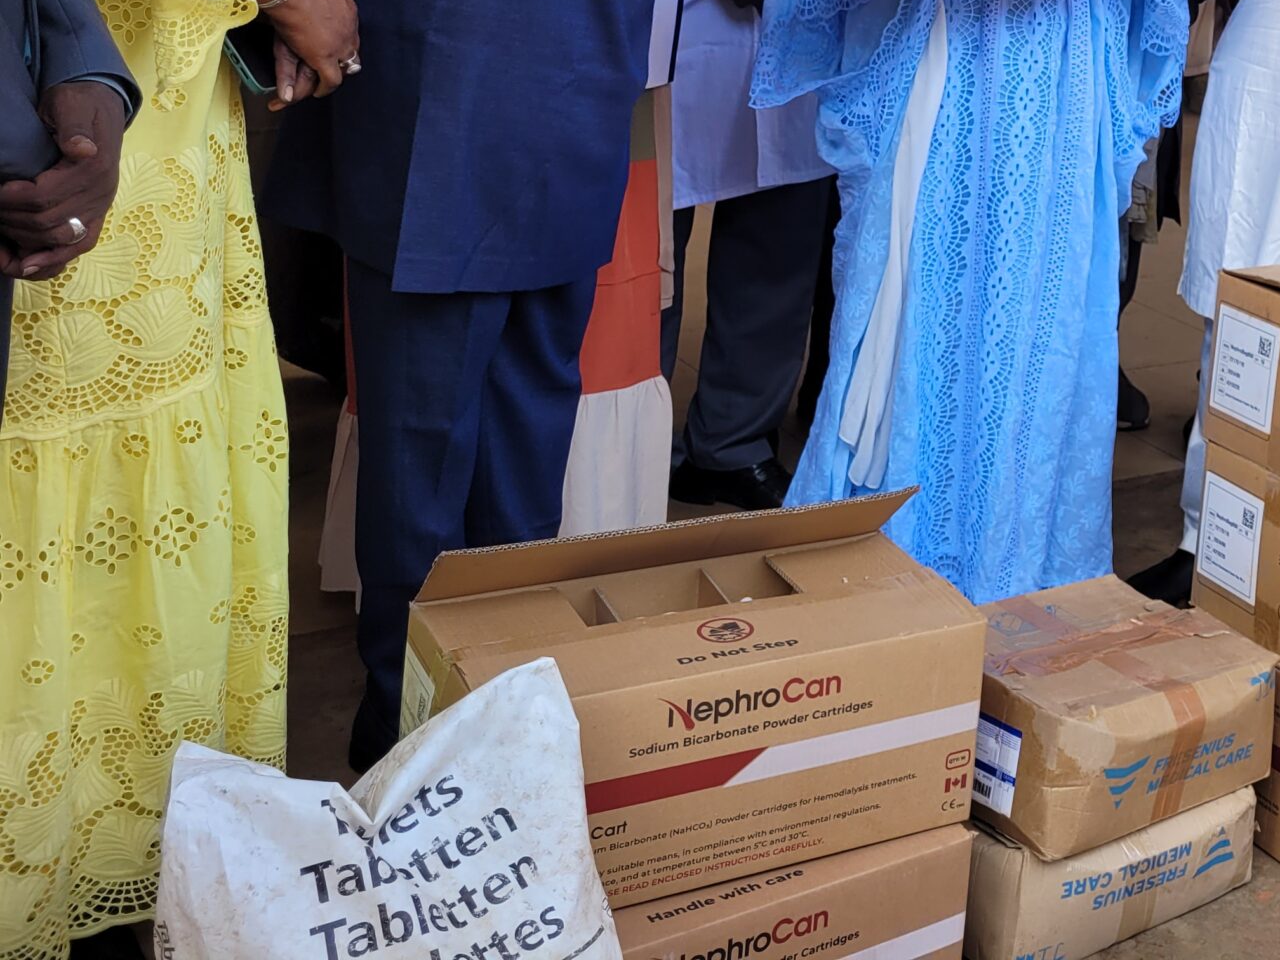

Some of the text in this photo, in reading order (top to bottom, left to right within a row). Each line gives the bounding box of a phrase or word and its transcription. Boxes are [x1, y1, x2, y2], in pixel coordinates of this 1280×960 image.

[677, 639, 799, 665] Do Not Step
[628, 700, 872, 758] Sodium Bicarbonate Powder Cartridges
[666, 676, 840, 729] NephroCan
[1215, 743, 1254, 768] CARE
[590, 820, 627, 839] Cart
[606, 860, 644, 874] suitable
[646, 852, 679, 865] means,
[682, 848, 691, 856] in
[692, 836, 745, 853] compliance
[746, 829, 767, 840] with
[768, 814, 831, 834] environmental
[832, 803, 880, 819] regulations.
[609, 832, 666, 851] Bicarbonate
[714, 812, 749, 825] Powder
[751, 801, 797, 816] Cartridges
[798, 797, 811, 806] for
[813, 784, 868, 802] Hemodialysis
[620, 871, 639, 882] and
[640, 869, 650, 877] at
[652, 855, 710, 874] temperature
[712, 845, 751, 859] between
[768, 835, 786, 845] and
[621, 880, 649, 893] READ
[651, 867, 702, 886] ENCLOSED
[704, 850, 770, 872] INSTRUCTIONS
[772, 837, 824, 855] CAREFULLY.
[1060, 841, 1192, 899] MEDICAL CARE
[309, 854, 539, 960] Tabletten
[646, 869, 804, 924] Handle with care
[1092, 862, 1188, 910] FRESENIUS
[801, 929, 860, 958] Cartridges
